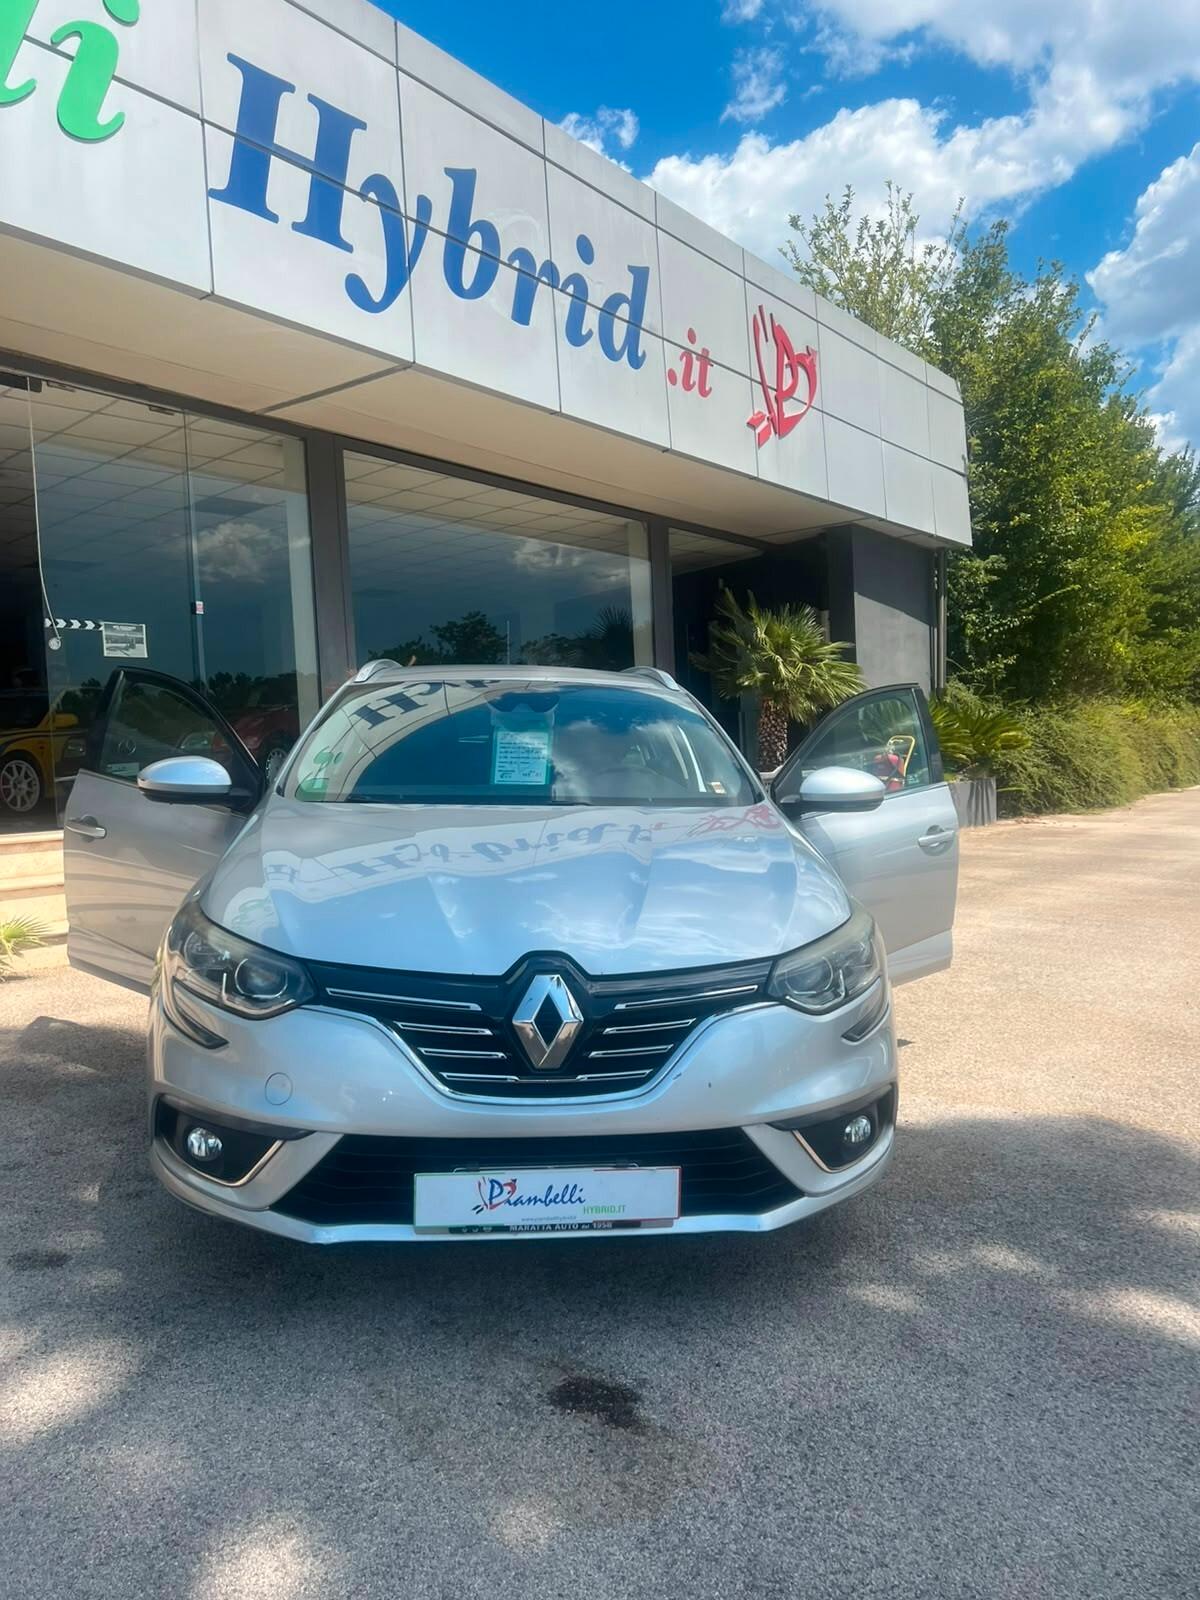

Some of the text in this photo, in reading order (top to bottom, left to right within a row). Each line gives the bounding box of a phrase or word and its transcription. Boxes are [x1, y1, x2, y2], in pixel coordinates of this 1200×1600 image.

[207, 53, 650, 371] Hybrid
[487, 1179, 586, 1207] Piambelli
[583, 1204, 626, 1215] HYBRID.IT
[554, 1222, 579, 1231] AUTO
